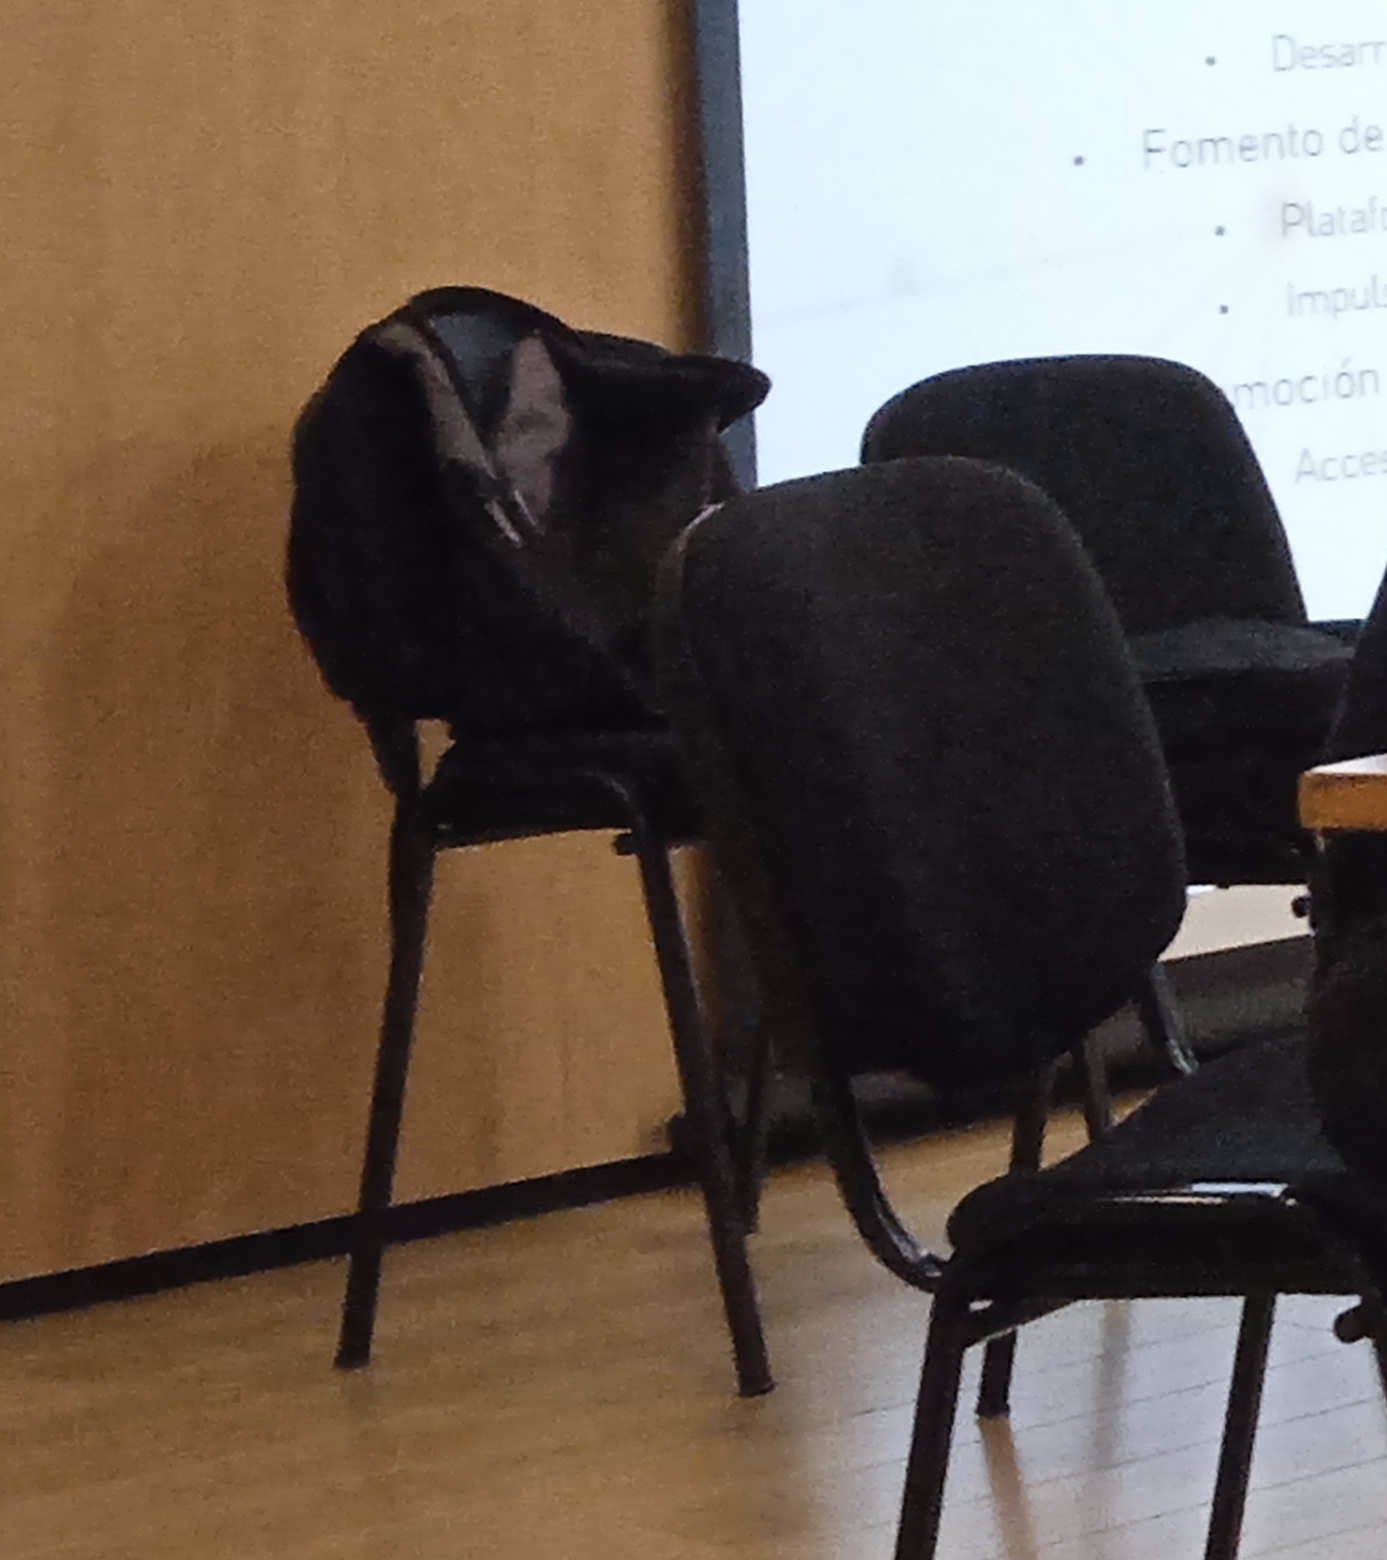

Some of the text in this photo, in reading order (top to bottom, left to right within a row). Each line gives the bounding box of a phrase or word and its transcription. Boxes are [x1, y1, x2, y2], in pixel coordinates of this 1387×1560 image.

[1142, 114, 1324, 171] Fomento
[1339, 114, 1383, 155] de
[1233, 357, 1380, 409] moción
